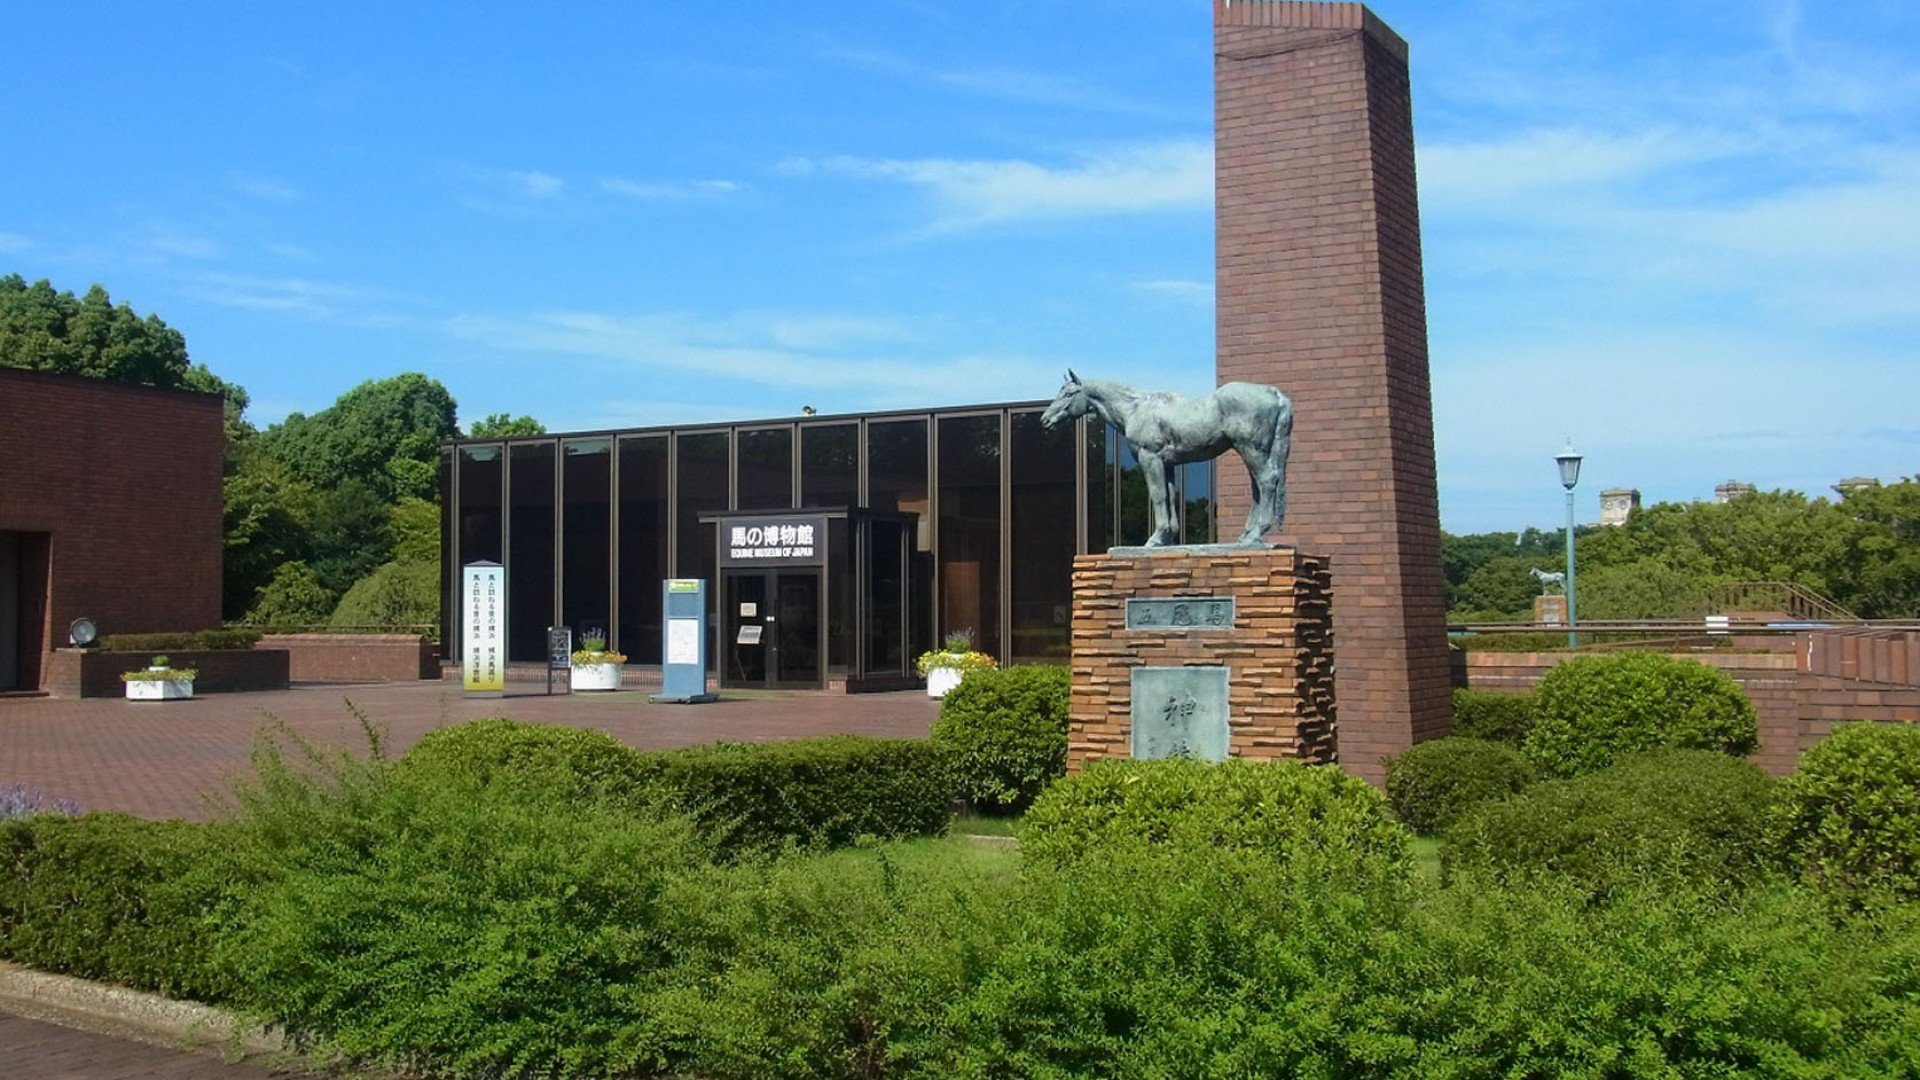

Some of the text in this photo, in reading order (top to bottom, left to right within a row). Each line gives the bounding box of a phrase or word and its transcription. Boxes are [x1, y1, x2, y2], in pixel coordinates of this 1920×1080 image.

[731, 525, 814, 546] 馬の博物館
[731, 547, 814, 558] EQUINE MUSEUM OF JAPAN
